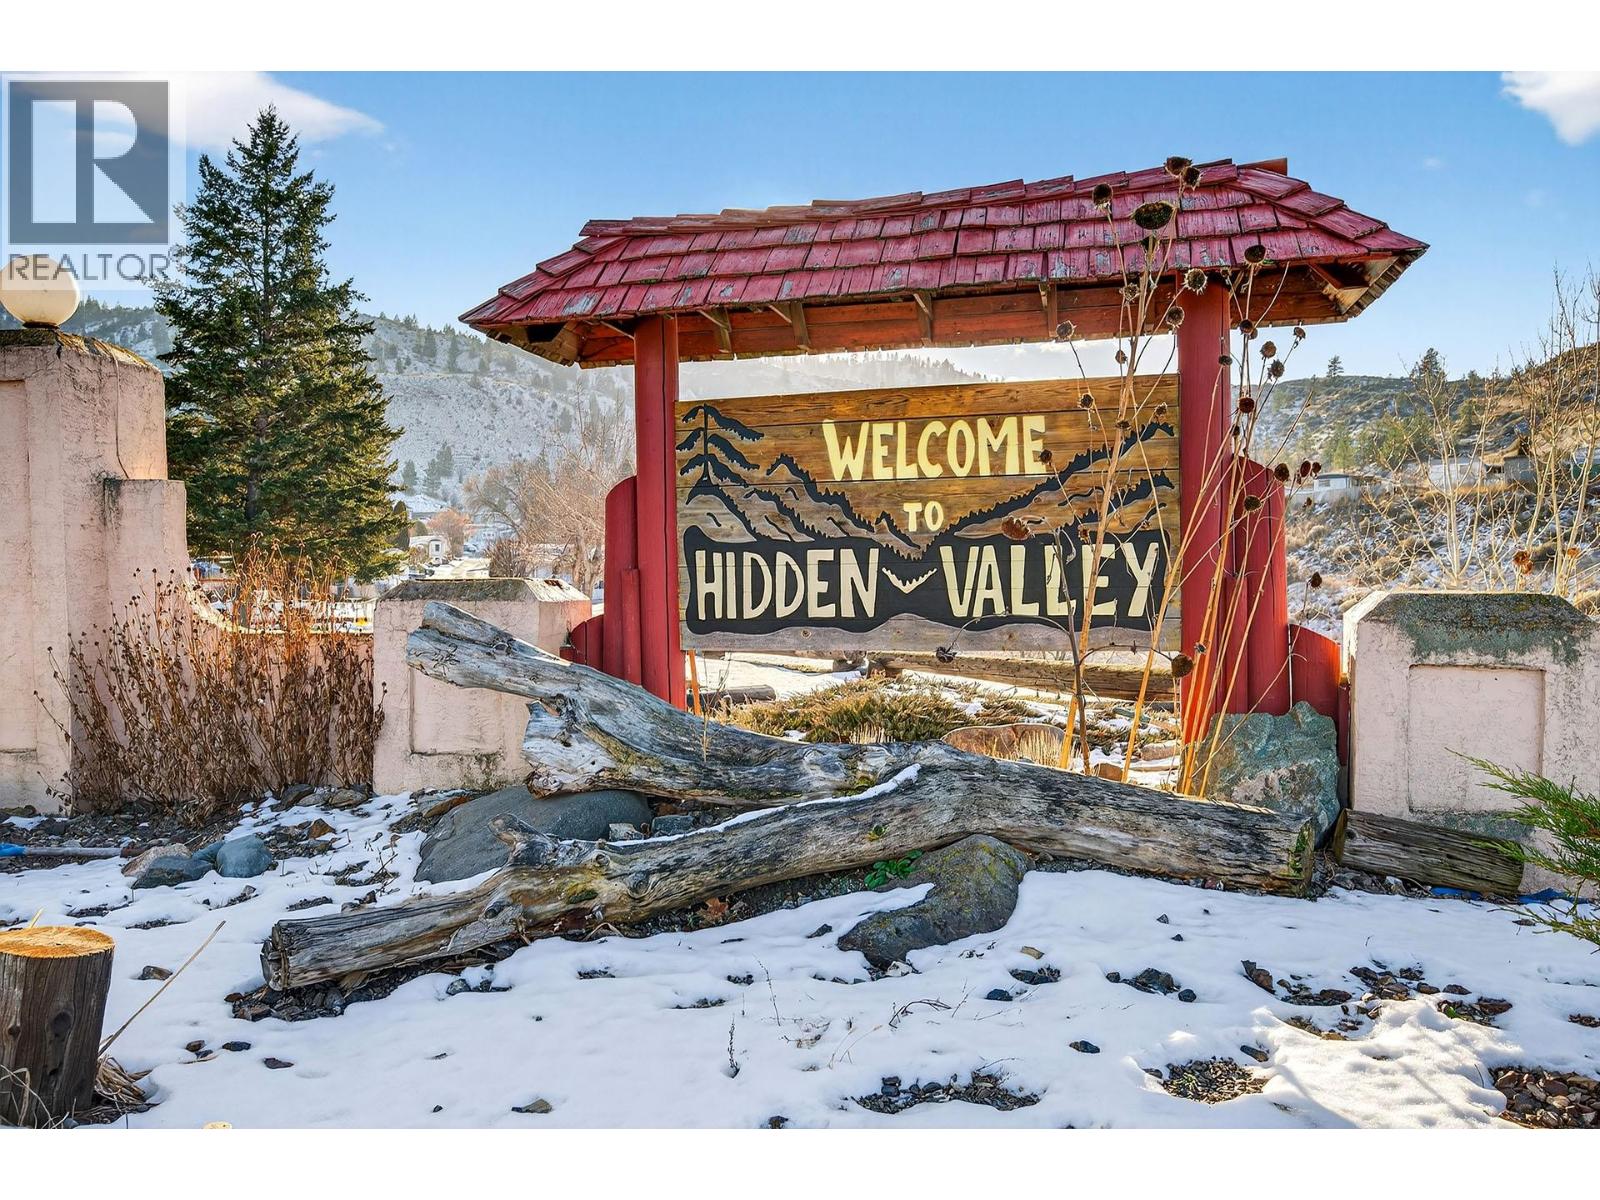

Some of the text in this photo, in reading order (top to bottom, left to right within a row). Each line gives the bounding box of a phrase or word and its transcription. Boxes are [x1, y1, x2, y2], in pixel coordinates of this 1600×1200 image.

[821, 415, 1048, 482] WELCOME
[903, 501, 944, 532] TO
[695, 542, 1160, 621] HIDDEN VALLEY
